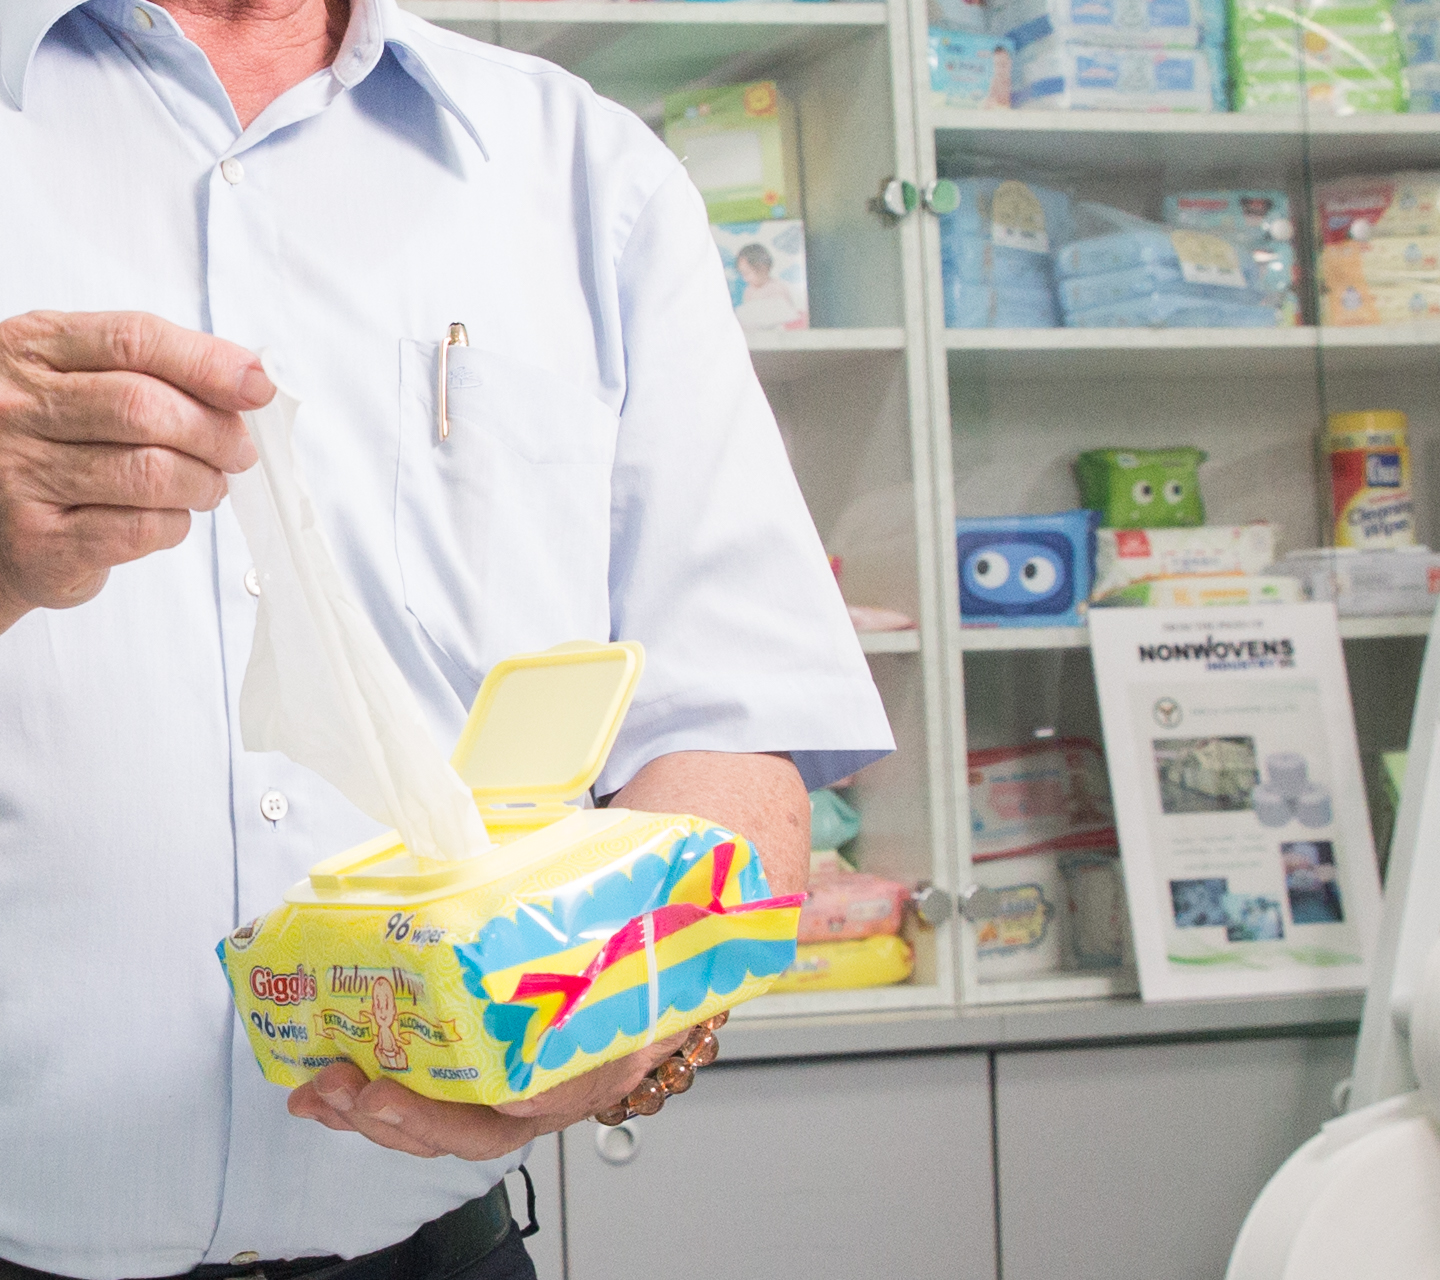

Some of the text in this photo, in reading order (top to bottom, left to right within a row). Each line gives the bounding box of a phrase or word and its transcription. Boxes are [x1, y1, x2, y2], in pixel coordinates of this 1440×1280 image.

[1138, 634, 1296, 664] NONWOVENS
[385, 912, 448, 948] 96 wipes
[250, 964, 317, 1007] Giggles
[330, 965, 374, 1004] Baby
[251, 1012, 309, 1042] 96 wipes
[324, 1013, 372, 1039] EXTRA-SOFT
[429, 1067, 480, 1081] UNSCENTED
